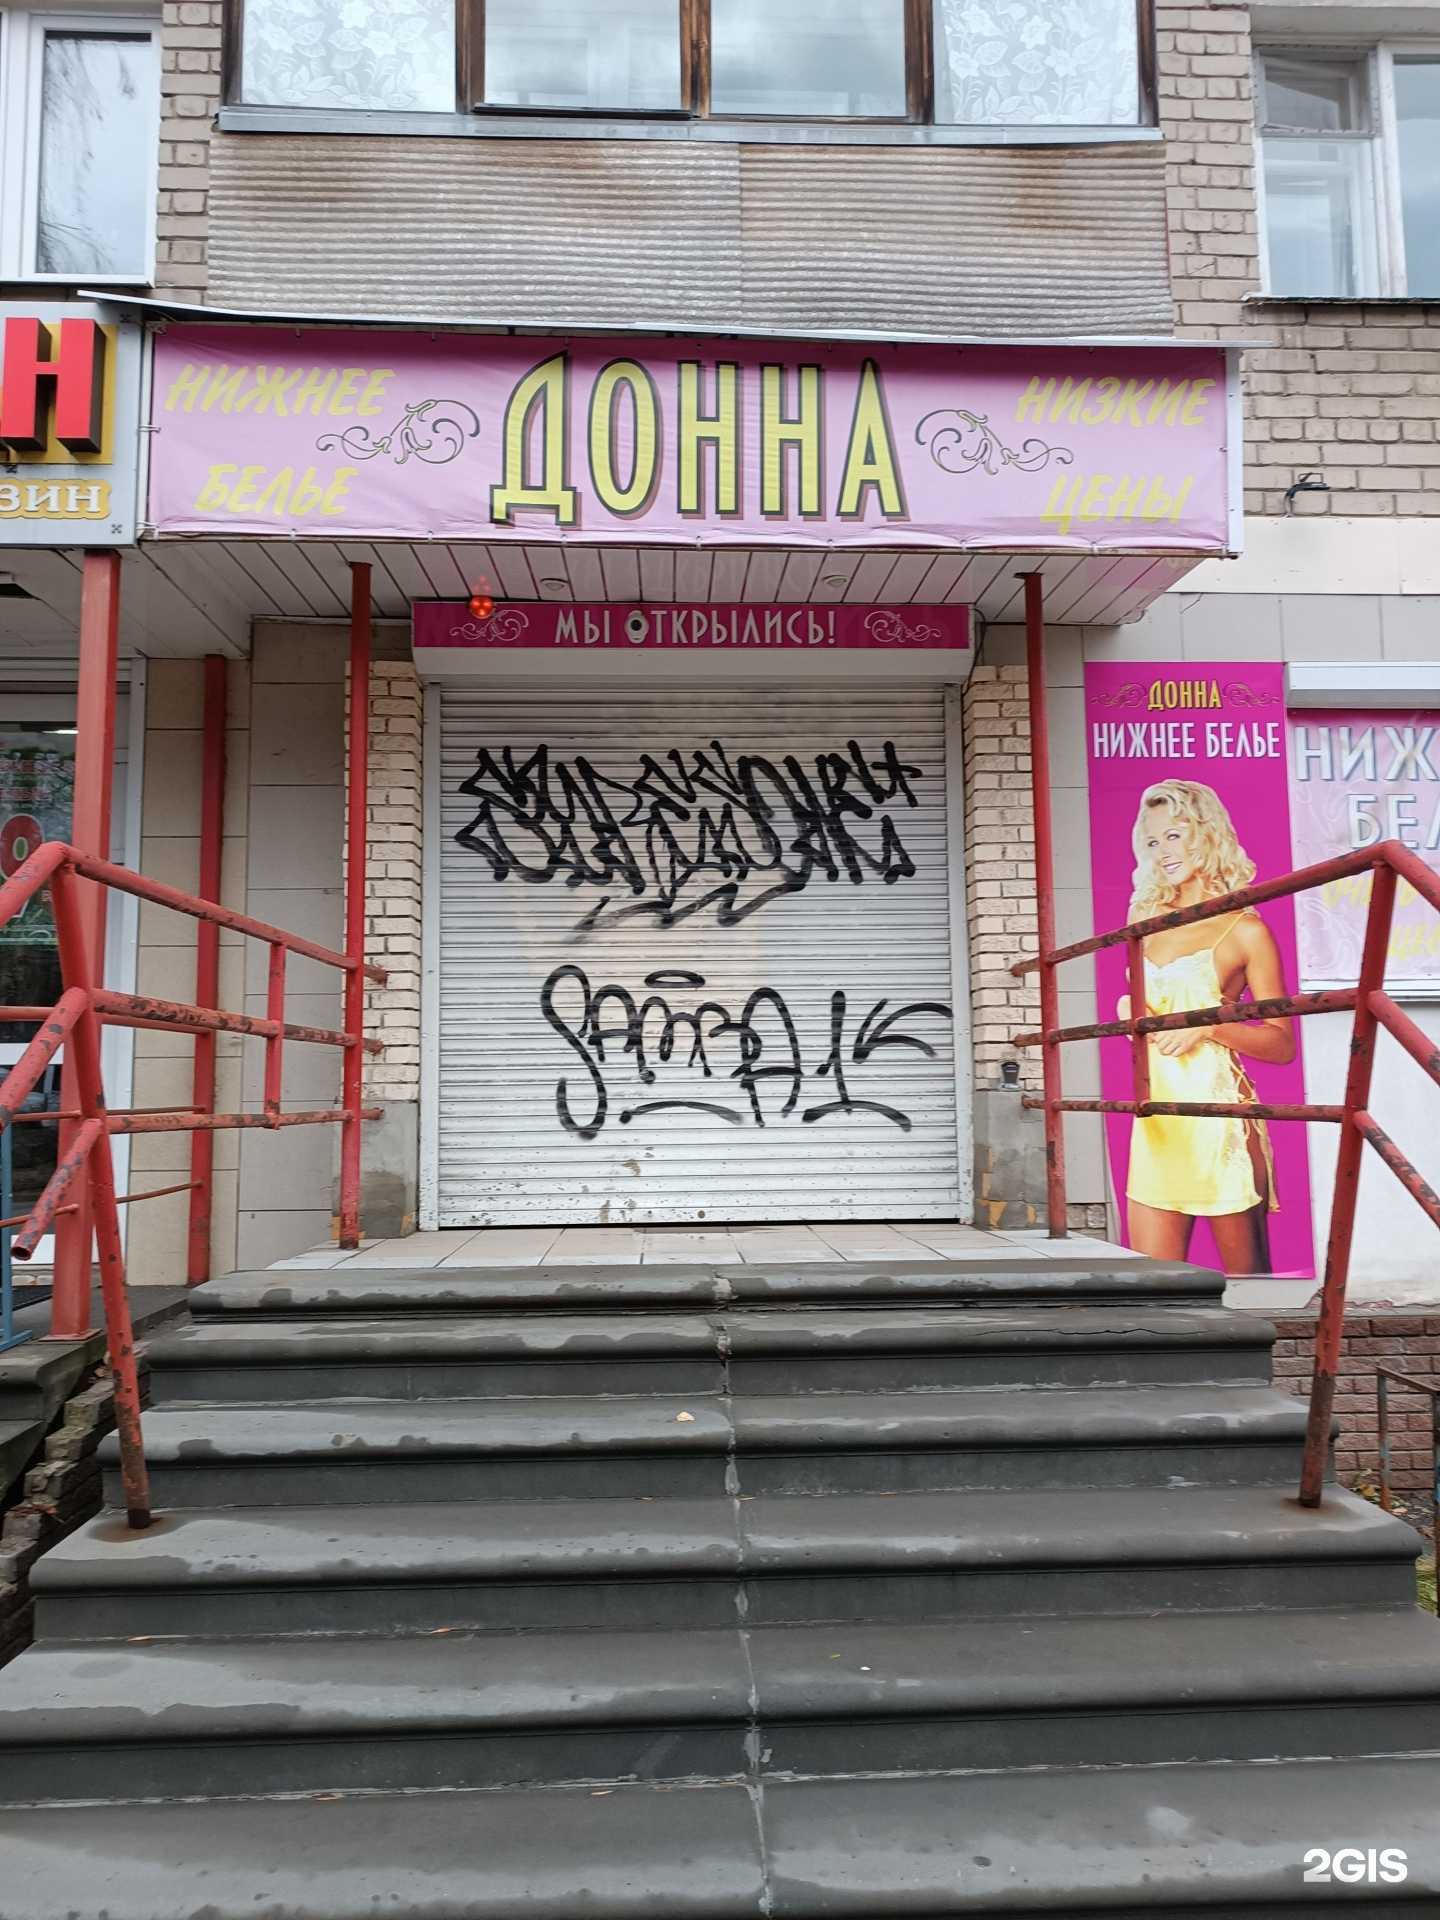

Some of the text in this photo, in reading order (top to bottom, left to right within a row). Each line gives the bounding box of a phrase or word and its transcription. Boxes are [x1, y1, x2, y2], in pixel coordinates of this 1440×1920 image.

[164, 364, 396, 417] НИЖНЕЕ
[1015, 375, 1216, 428] НИЗКИЕ
[490, 350, 910, 530] ДОННА
[193, 463, 360, 517] БЕЛЬЕ
[1040, 472, 1195, 536] ЦЕНЫ
[555, 609, 610, 644] МЫ
[1147, 679, 1222, 711] ДОННА
[1093, 722, 1281, 758] НИЖНЕЕ БЕЛЬЕ
